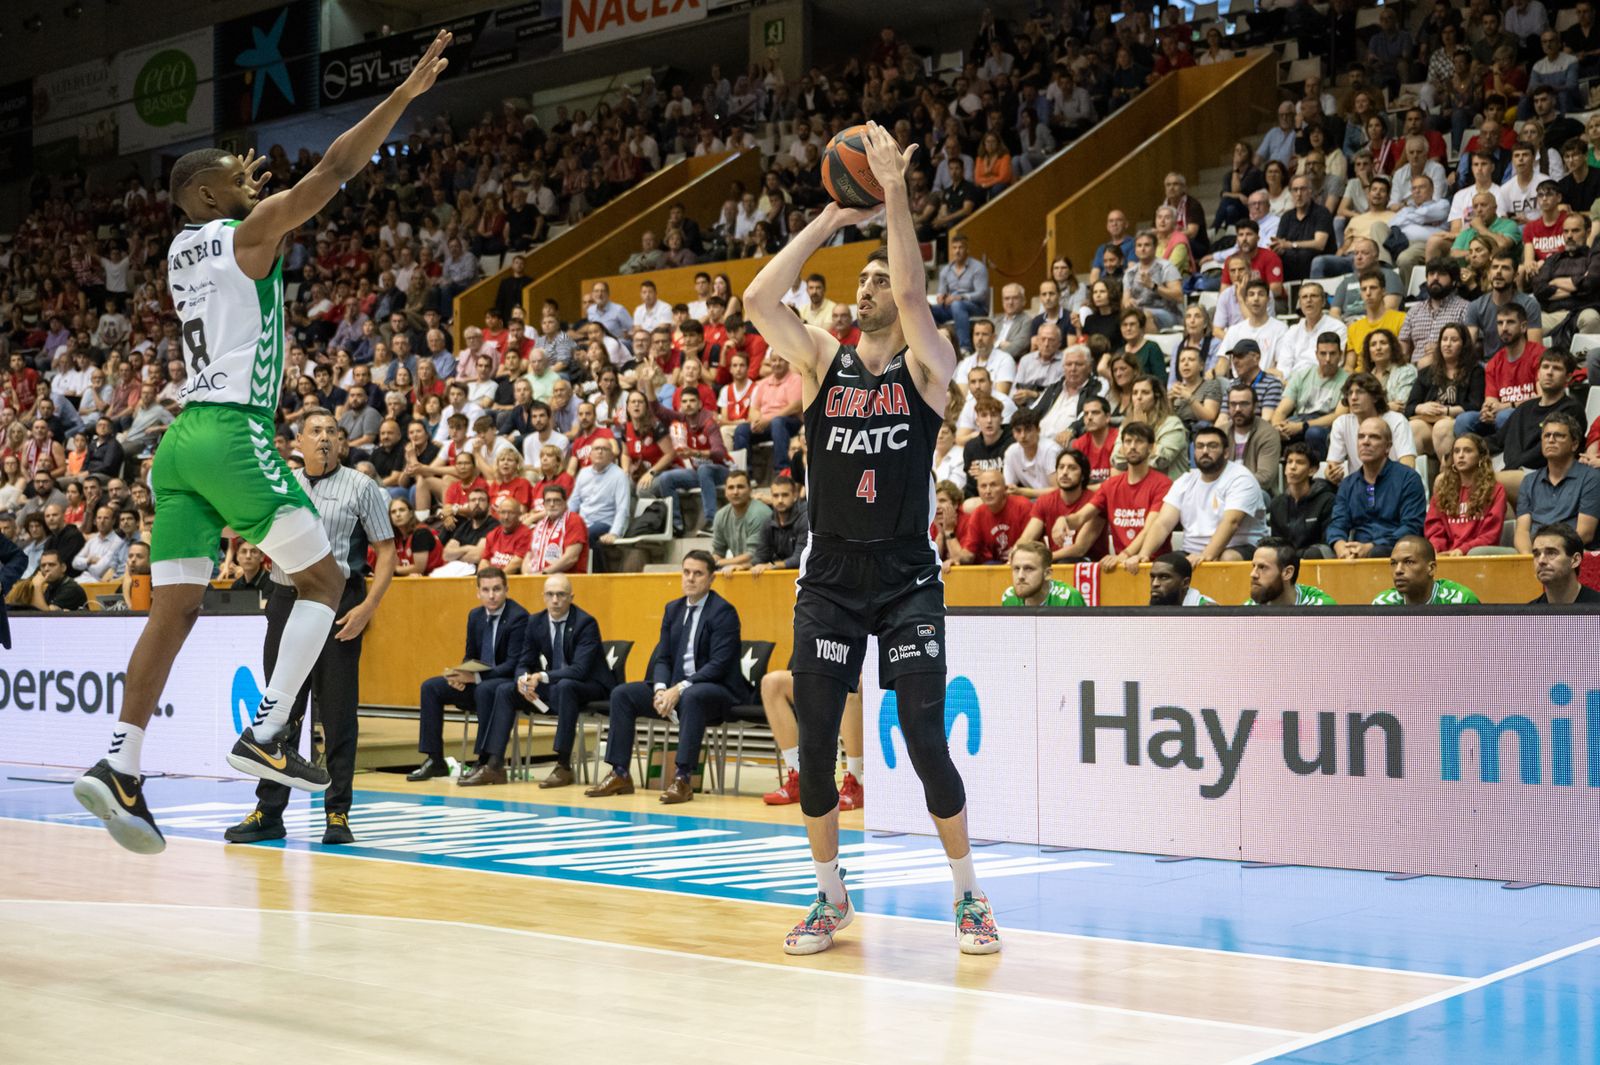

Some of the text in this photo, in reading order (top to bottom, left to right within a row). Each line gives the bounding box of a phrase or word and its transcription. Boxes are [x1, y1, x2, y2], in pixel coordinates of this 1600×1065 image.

[143, 60, 187, 95] eco
[143, 89, 187, 115] BASICS
[183, 317, 211, 375] 8
[825, 383, 911, 419] GIRONA
[826, 423, 910, 455] FIATC
[856, 469, 877, 504] 4
[816, 638, 850, 665] YOSOY
[899, 643, 916, 653] Kave
[899, 650, 921, 660] Home
[1079, 680, 1258, 799] Hay
[1282, 710, 1404, 779] un
